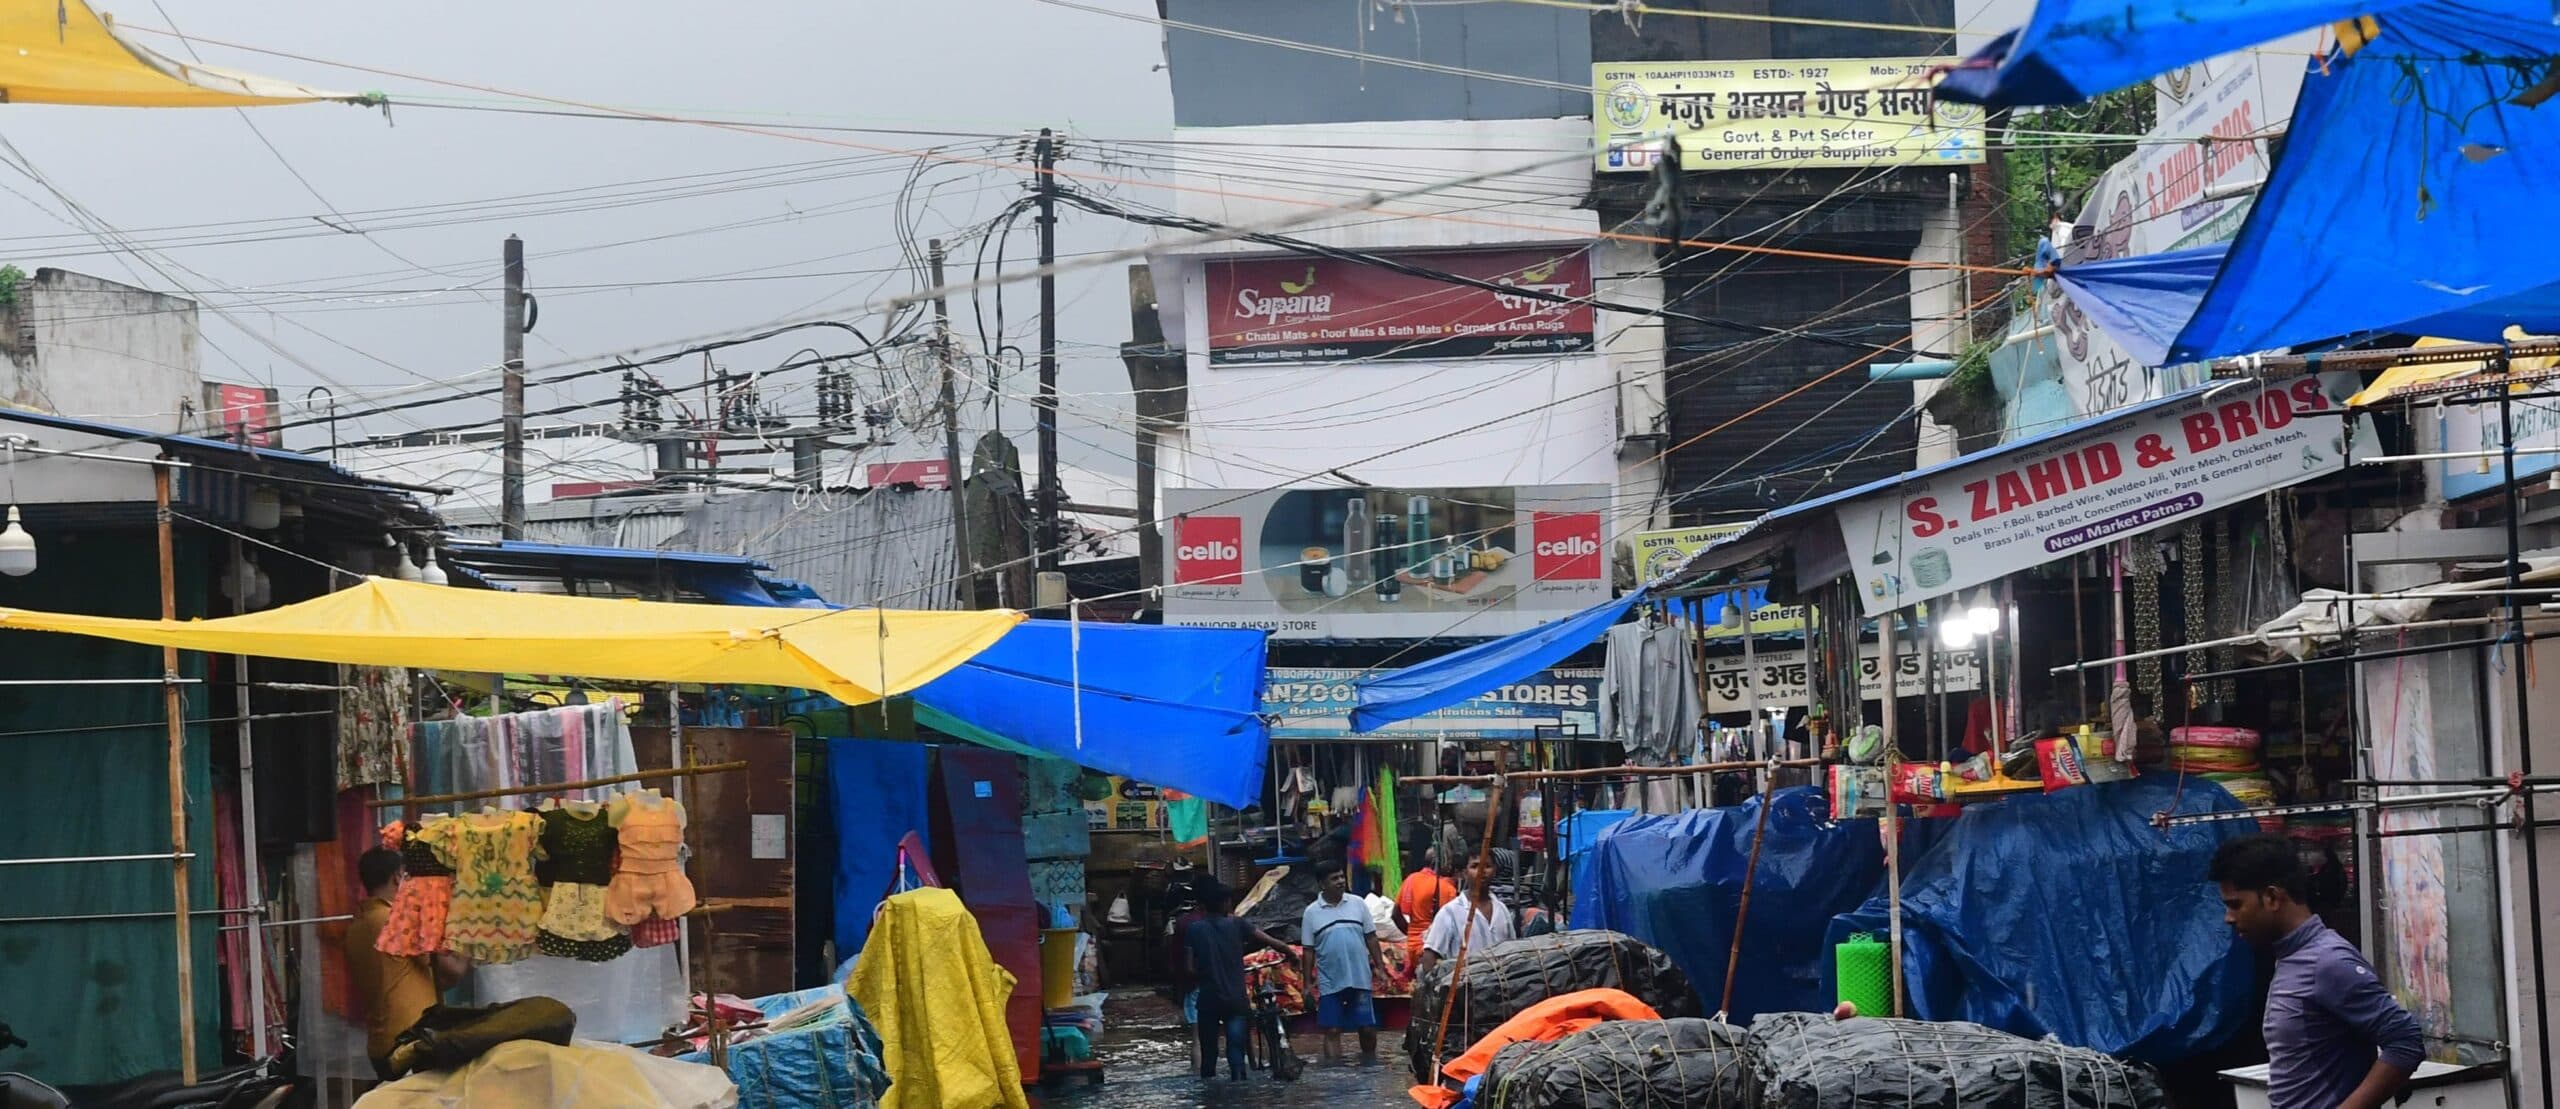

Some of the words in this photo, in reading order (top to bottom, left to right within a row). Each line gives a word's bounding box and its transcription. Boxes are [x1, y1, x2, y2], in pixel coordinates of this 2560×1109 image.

[1605, 71, 1636, 81] GSTIN
[1800, 68, 1829, 78] 1927
[1723, 130, 1765, 143] Govt.
[1771, 129, 1782, 142] &
[1789, 129, 1815, 142] Pvt
[1820, 128, 1874, 141] Secter
[1701, 147, 1765, 161] General
[1770, 146, 1815, 160] Order
[1822, 145, 1898, 161] Suppliers
[1235, 288, 1332, 325] Sapana
[1320, 328, 1347, 339] Door
[1349, 326, 1375, 338] Mats
[1377, 326, 1386, 337] &
[1388, 325, 1414, 336] Bath
[1416, 324, 1442, 335] Mats
[1454, 322, 1496, 335] Carpets
[1498, 321, 1506, 331] &
[1508, 321, 1534, 332] Area
[1536, 320, 1565, 331] Rugs
[1283, 330, 1308, 341] Mats
[1906, 496, 1959, 539] S.
[1963, 441, 2123, 523] ZAHID
[2133, 433, 2177, 469] &
[2180, 376, 2330, 454] BROS
[1952, 531, 1982, 545] Deals
[2036, 501, 2074, 519] Barbed
[2076, 494, 2105, 507] Wire,
[2170, 464, 2196, 478] Wire
[2197, 453, 2230, 469] Mesh,
[2231, 439, 2273, 458] Chicken
[2274, 430, 2307, 445] Mesh,
[1984, 537, 2012, 550] Brass
[2036, 523, 2056, 533] Nut
[2144, 486, 2173, 501] Wire,
[2174, 477, 2200, 491] Pant
[2201, 473, 2210, 483] &
[2211, 459, 2253, 479] General
[2254, 452, 2284, 466] order
[2049, 530, 2084, 551] New
[2086, 513, 2140, 540] Market
[2141, 496, 2199, 522] Patna-1
[1536, 535, 1598, 557] cello
[1643, 537, 1675, 548] GSTIN
[1177, 541, 1238, 561] cello
[1749, 607, 1805, 622] Genera
[1282, 620, 1318, 631] STORE
[1895, 678, 1916, 688] rder
[1758, 692, 1777, 700] ovt.
[1791, 688, 1808, 697] Pvt
[1495, 706, 1524, 716] Sale
